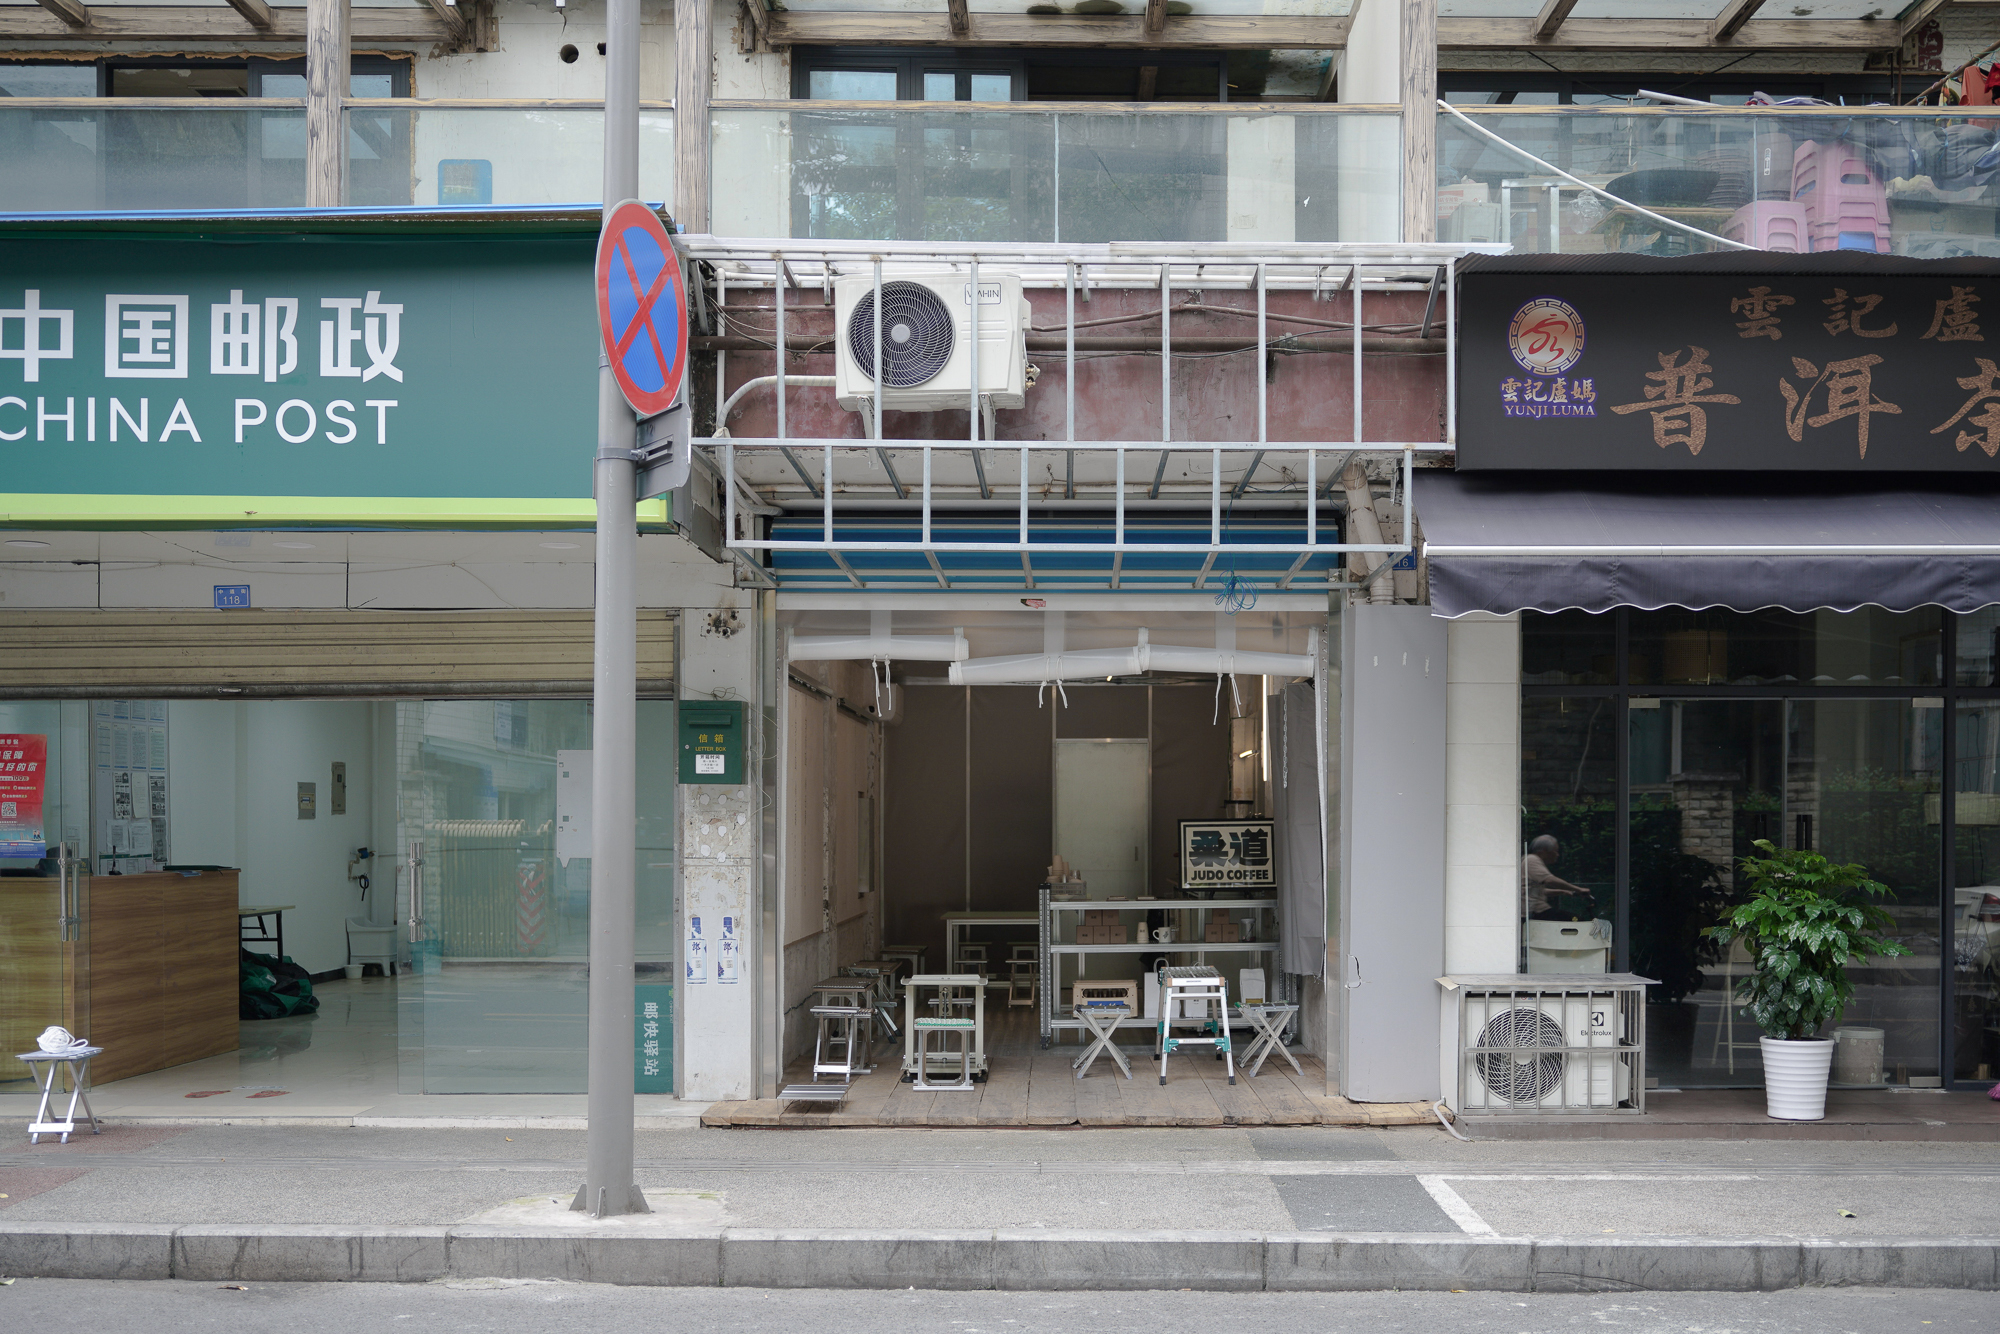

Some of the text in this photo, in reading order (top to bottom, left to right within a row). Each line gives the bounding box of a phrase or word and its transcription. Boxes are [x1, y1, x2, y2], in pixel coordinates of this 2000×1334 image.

[0, 288, 404, 383] 中国邮政
[1501, 377, 1596, 403] 雲記盧媽
[0, 396, 398, 445] CHINA POST
[1505, 405, 1595, 418] YUNJI LUMA
[223, 596, 240, 604] 118
[699, 734, 724, 743] 信箱
[0, 750, 23, 760] 保障
[1188, 828, 1271, 868] 柔道
[1191, 869, 1269, 880] JUDO COFFEE
[643, 1002, 659, 1076] 邮快驿站
